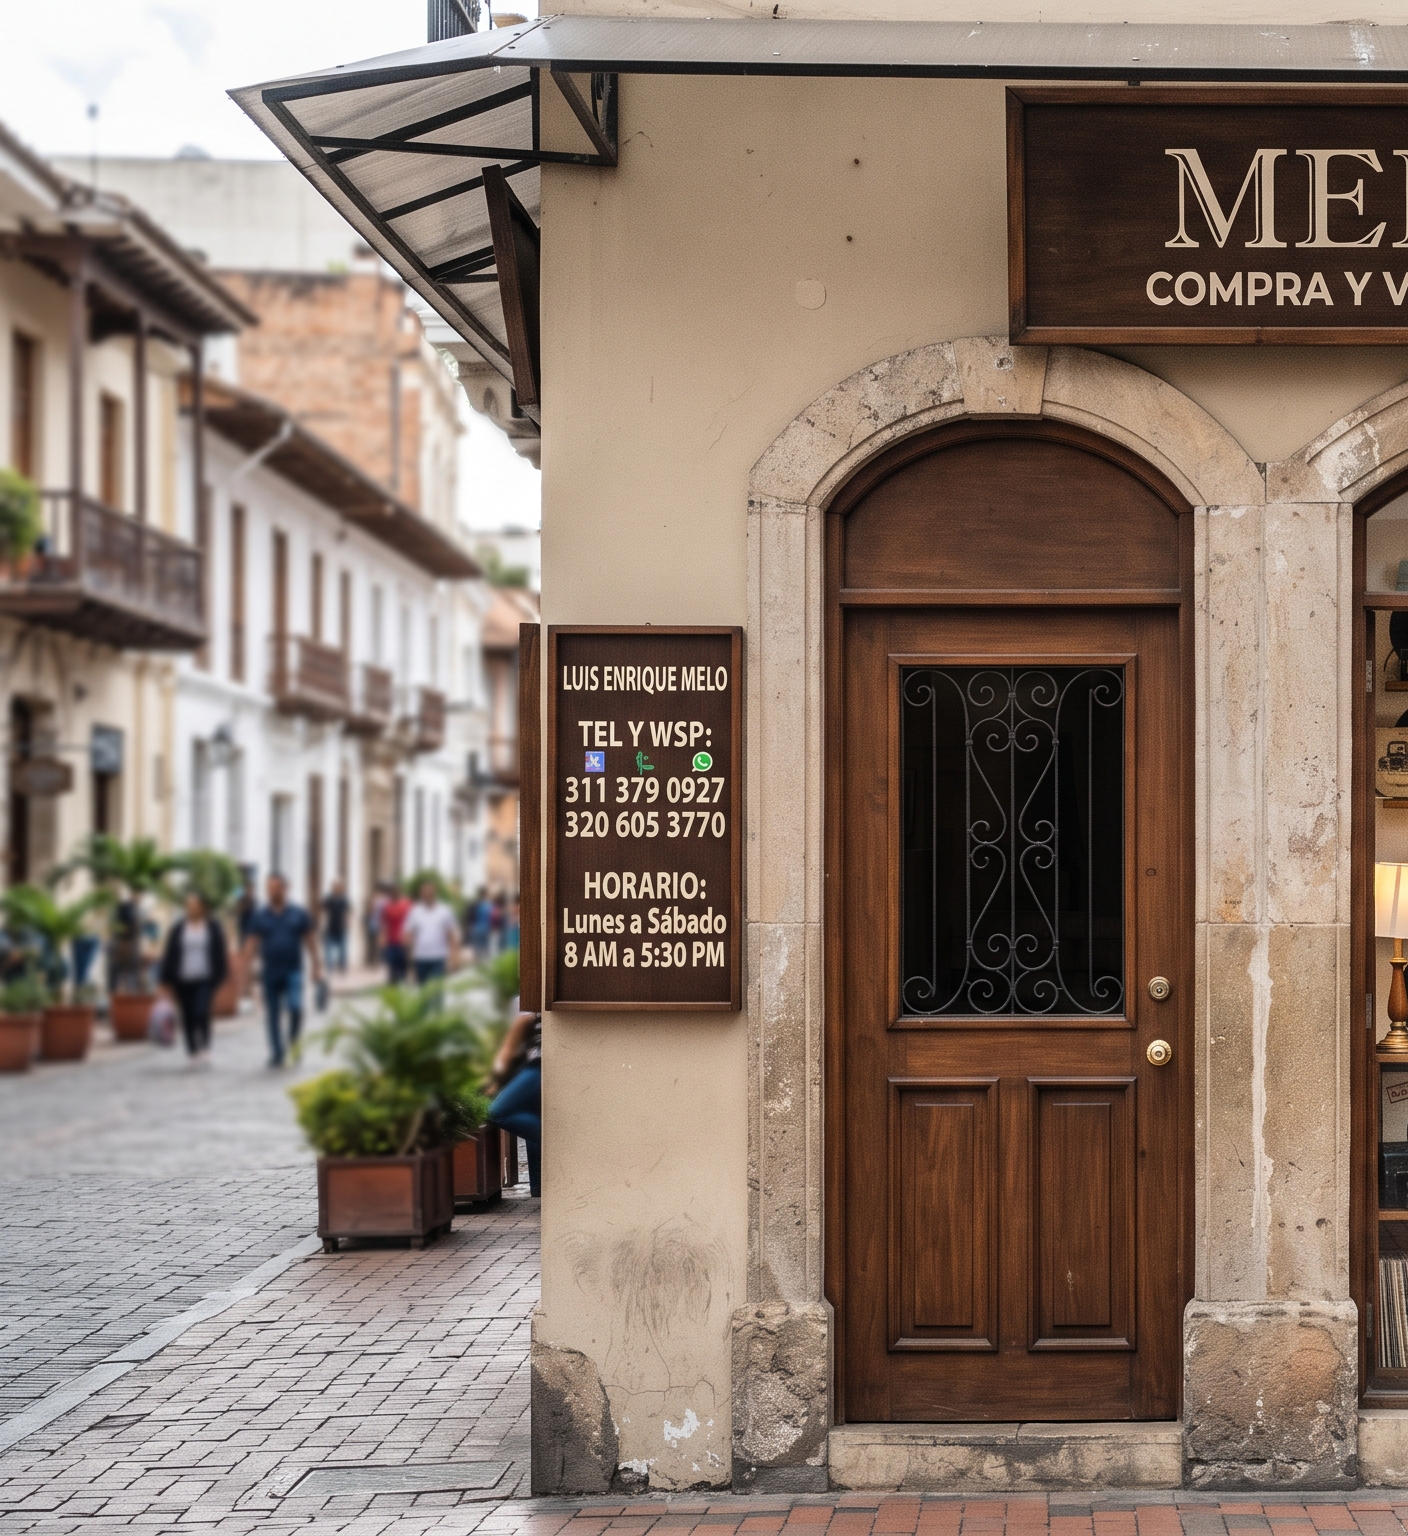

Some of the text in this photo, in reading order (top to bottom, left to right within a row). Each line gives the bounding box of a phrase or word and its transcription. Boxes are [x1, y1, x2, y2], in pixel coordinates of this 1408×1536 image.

[1147, 272, 1333, 306] COMPRA
[1345, 272, 1372, 305] Y
[563, 665, 727, 694] LUIS ENRIQUE MELO
[578, 721, 712, 747] TEL Y WSP:
[566, 777, 724, 803] 311 379 0927
[566, 811, 725, 837] 320 605 3770
[584, 872, 706, 899] HORARIO:
[564, 906, 727, 934] Lunes a Sábado
[565, 941, 725, 967] 8 AM a 5:30 PM
